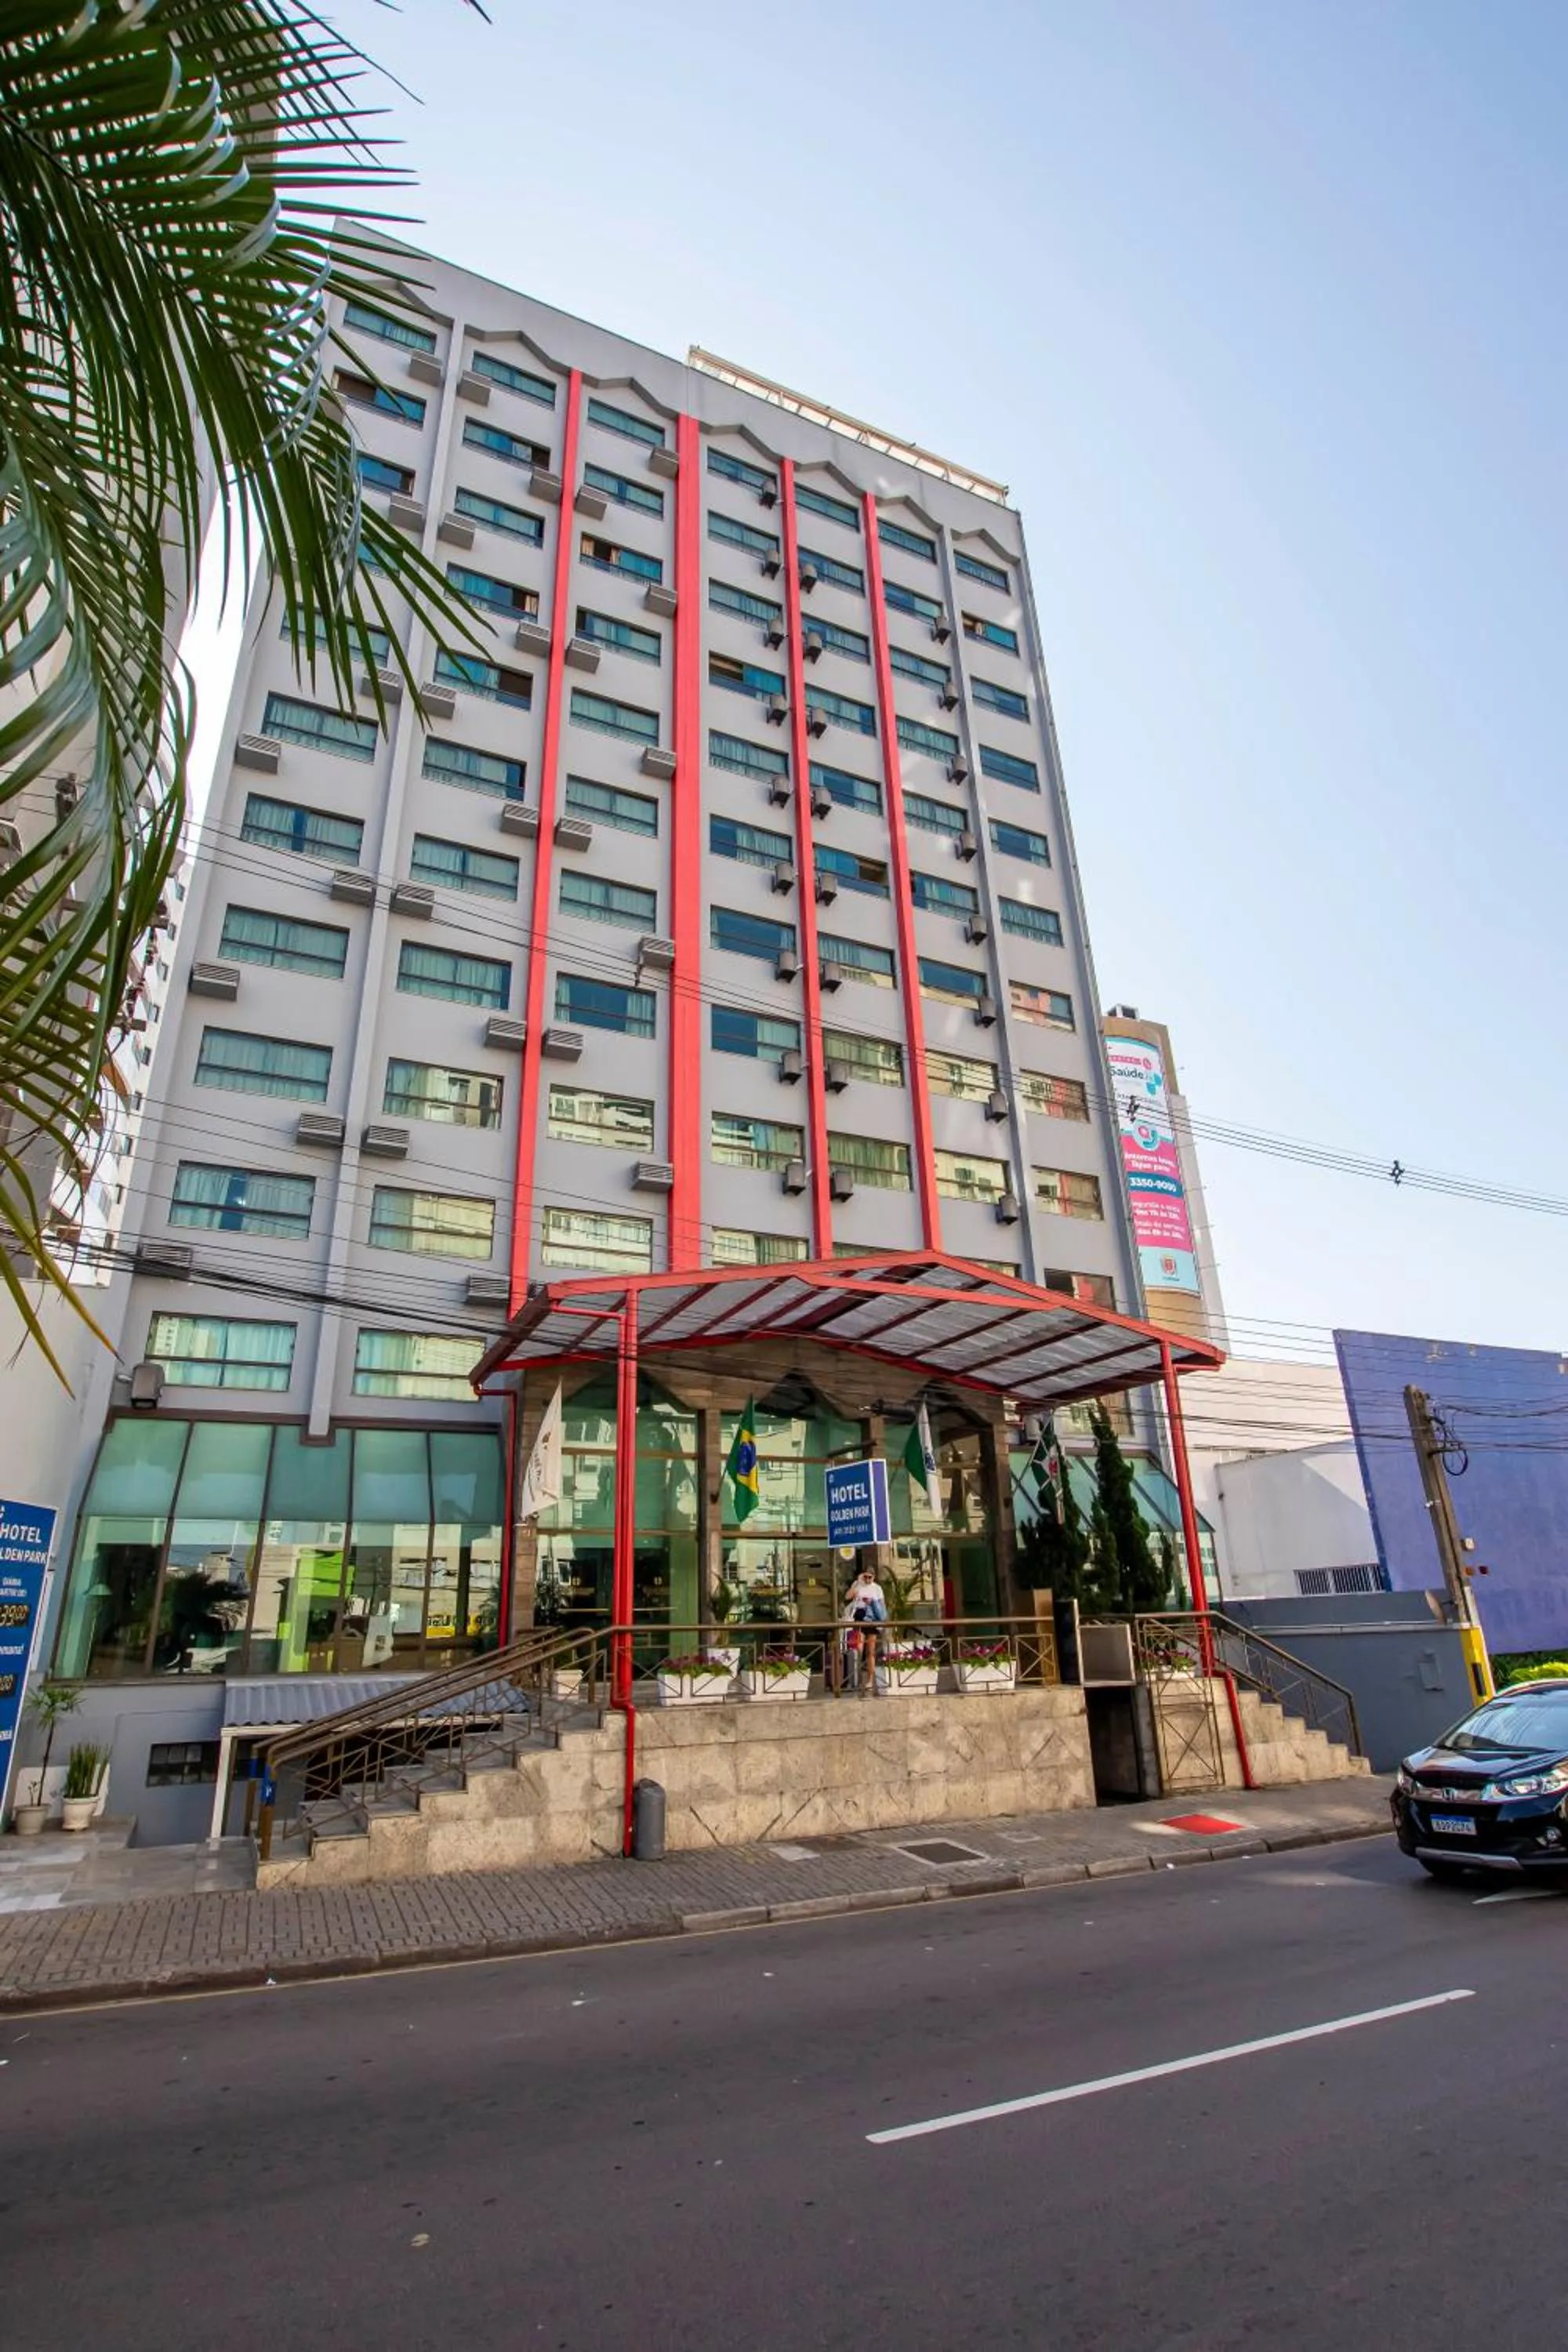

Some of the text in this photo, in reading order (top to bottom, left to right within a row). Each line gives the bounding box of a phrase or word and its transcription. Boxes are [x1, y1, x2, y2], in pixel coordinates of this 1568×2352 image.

[831, 1483, 868, 1504] HOTEL
[830, 1507, 854, 1523] GOLDEN
[0, 1522, 42, 1544] HOTEL
[24, 1549, 48, 1564] PARK
